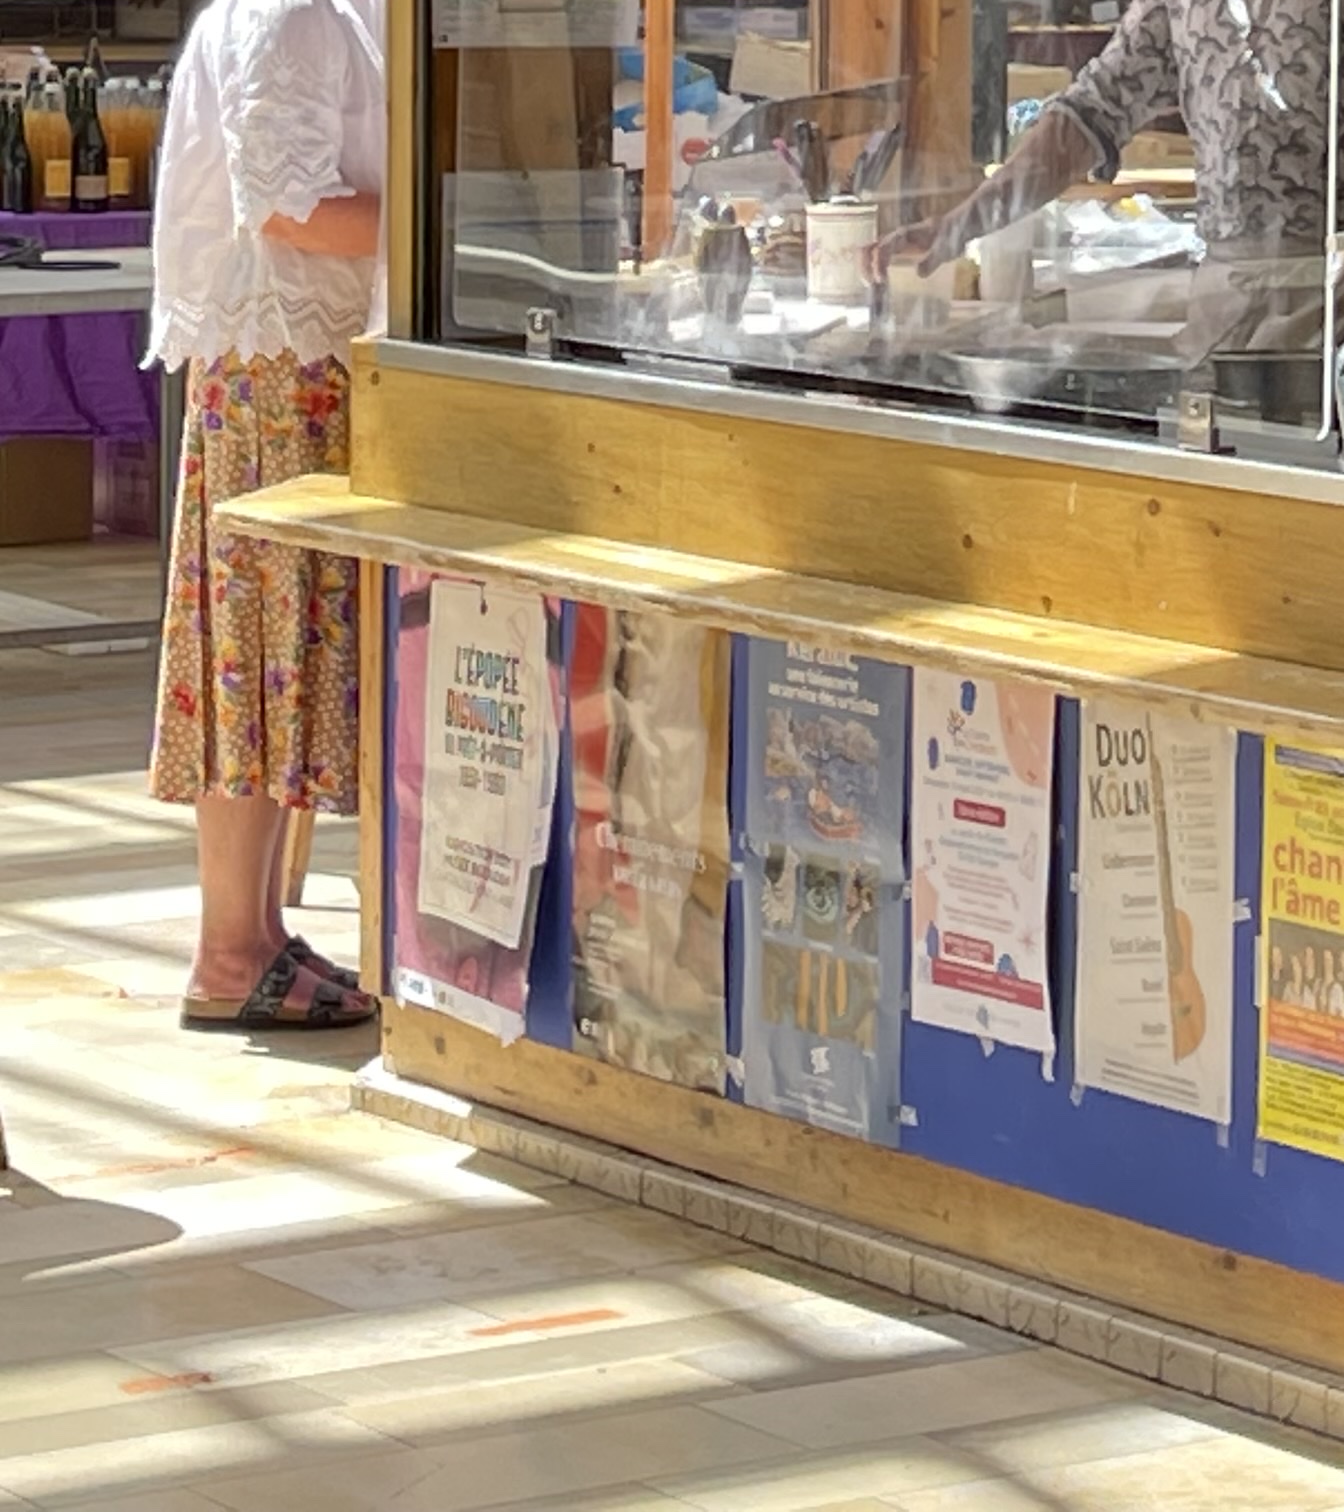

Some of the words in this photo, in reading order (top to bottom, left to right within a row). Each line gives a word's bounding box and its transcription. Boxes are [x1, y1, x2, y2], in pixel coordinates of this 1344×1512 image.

[1096, 723, 1146, 767] DUO
[1088, 769, 1151, 819] KÖLN
[1272, 876, 1341, 926] l'âme
